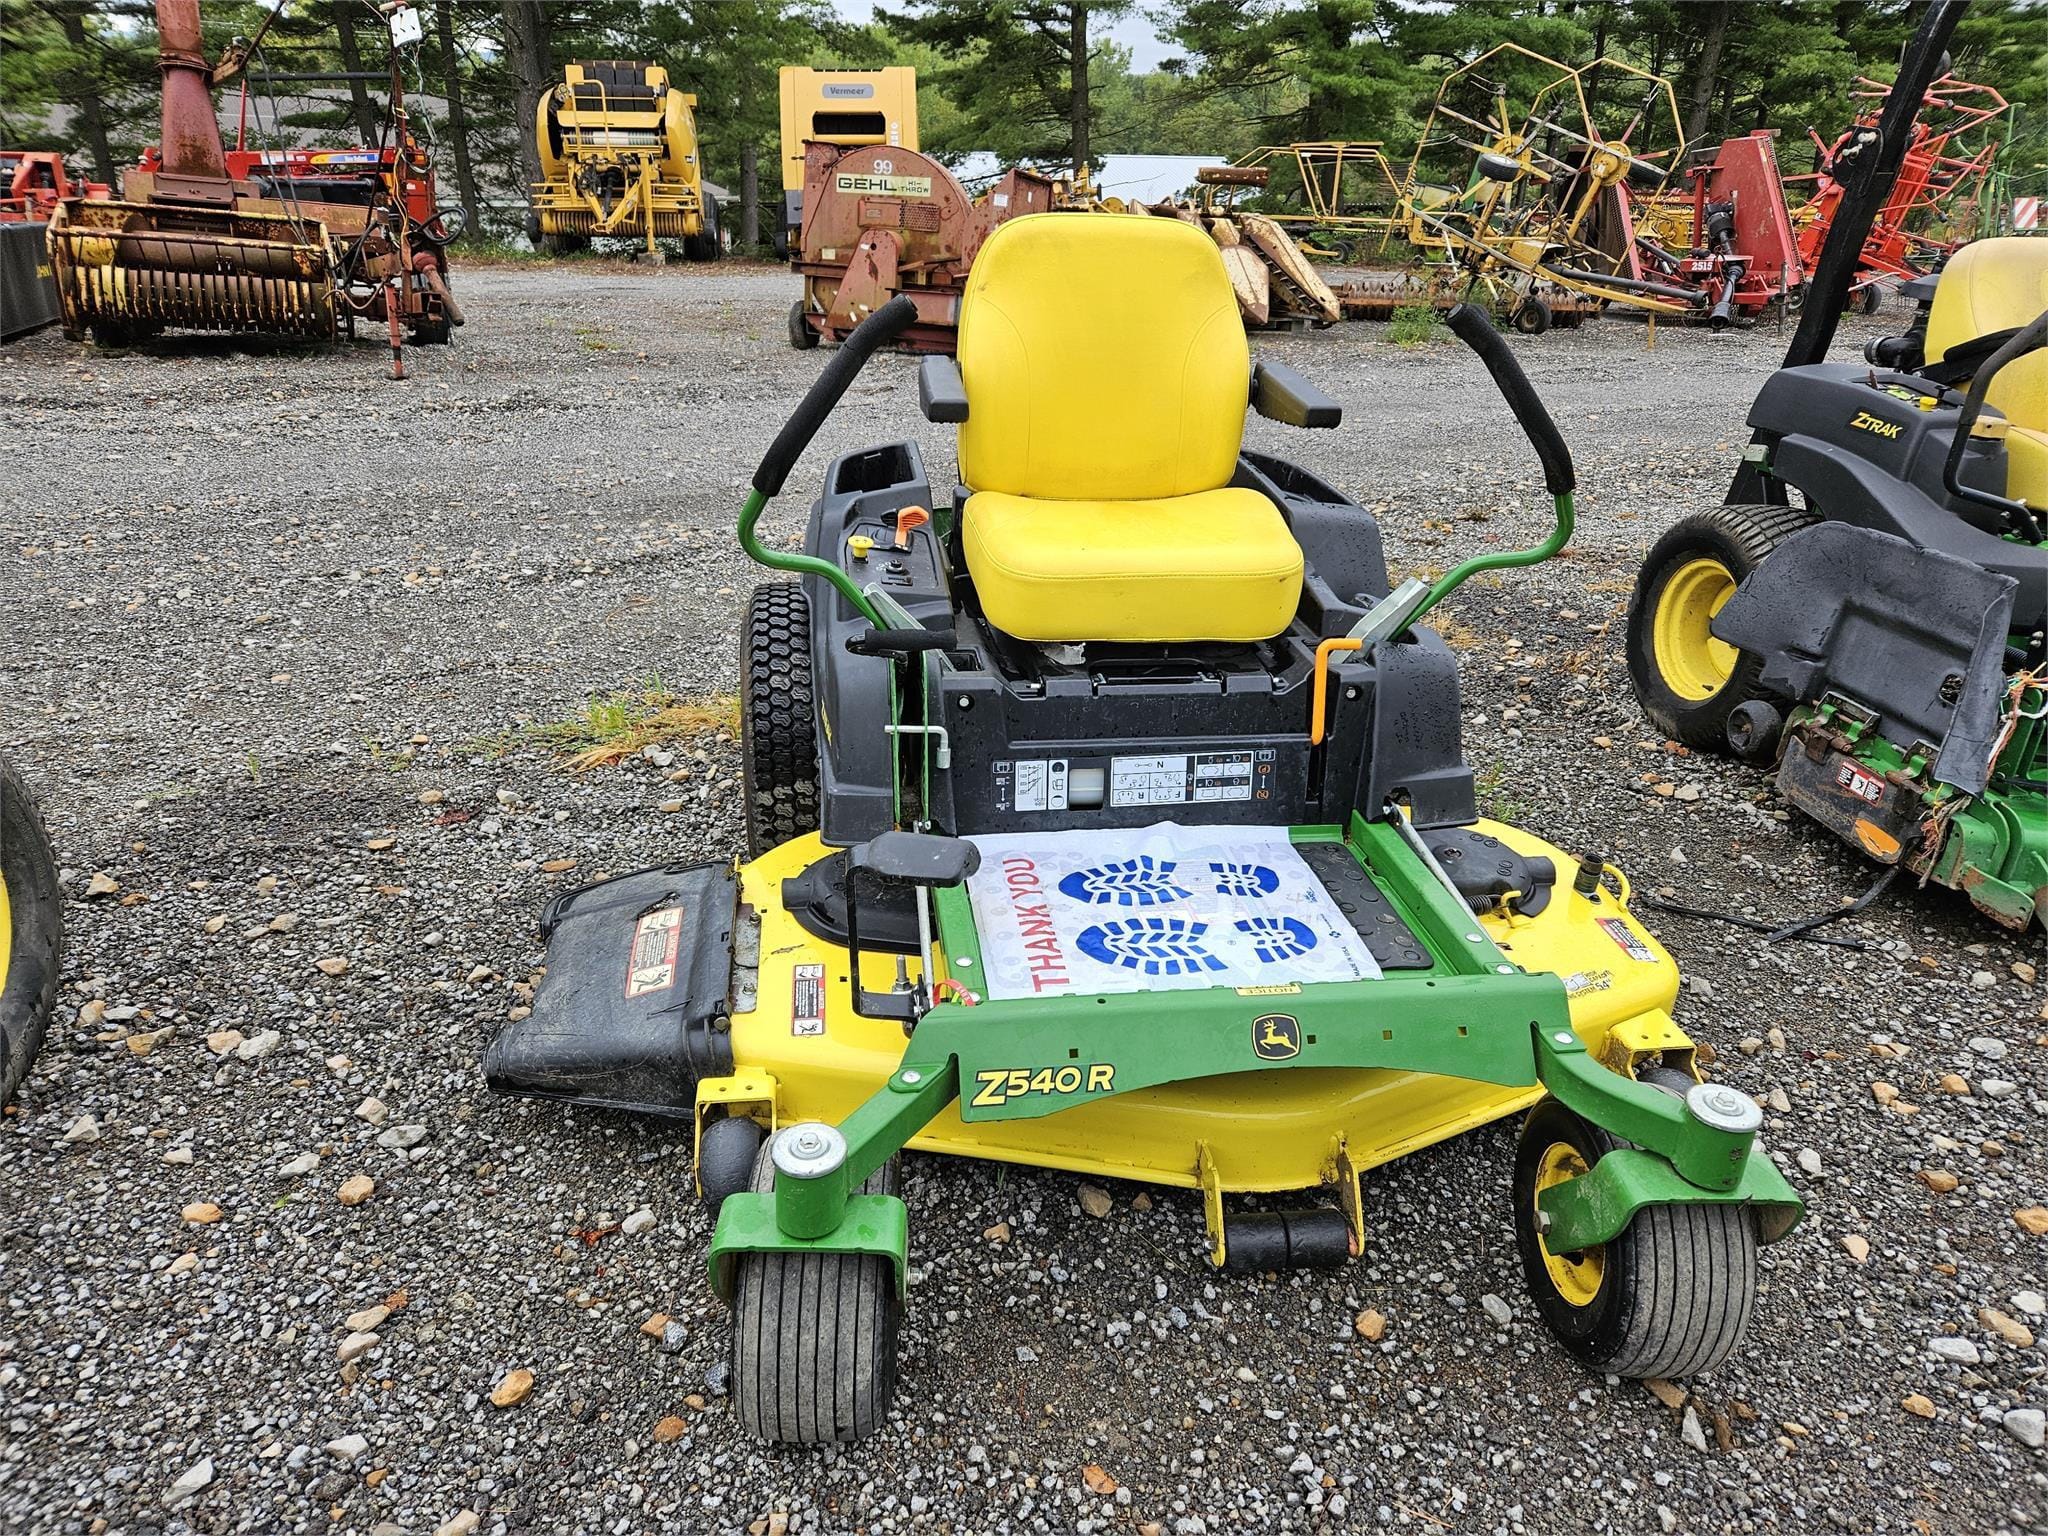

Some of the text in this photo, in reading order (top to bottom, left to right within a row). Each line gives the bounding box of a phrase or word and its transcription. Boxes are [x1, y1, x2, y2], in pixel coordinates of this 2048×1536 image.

[829, 86, 865, 96] Vermeer
[873, 159, 894, 175] 99
[838, 177, 898, 192] GEHL
[1691, 260, 1714, 272] 2515
[1850, 411, 1903, 439] ZTRAK
[1156, 760, 1164, 769] N
[1002, 858, 1070, 993] THANK YOU
[1246, 986, 1294, 995] NOTICE
[970, 1063, 1116, 1108] Z540 R
